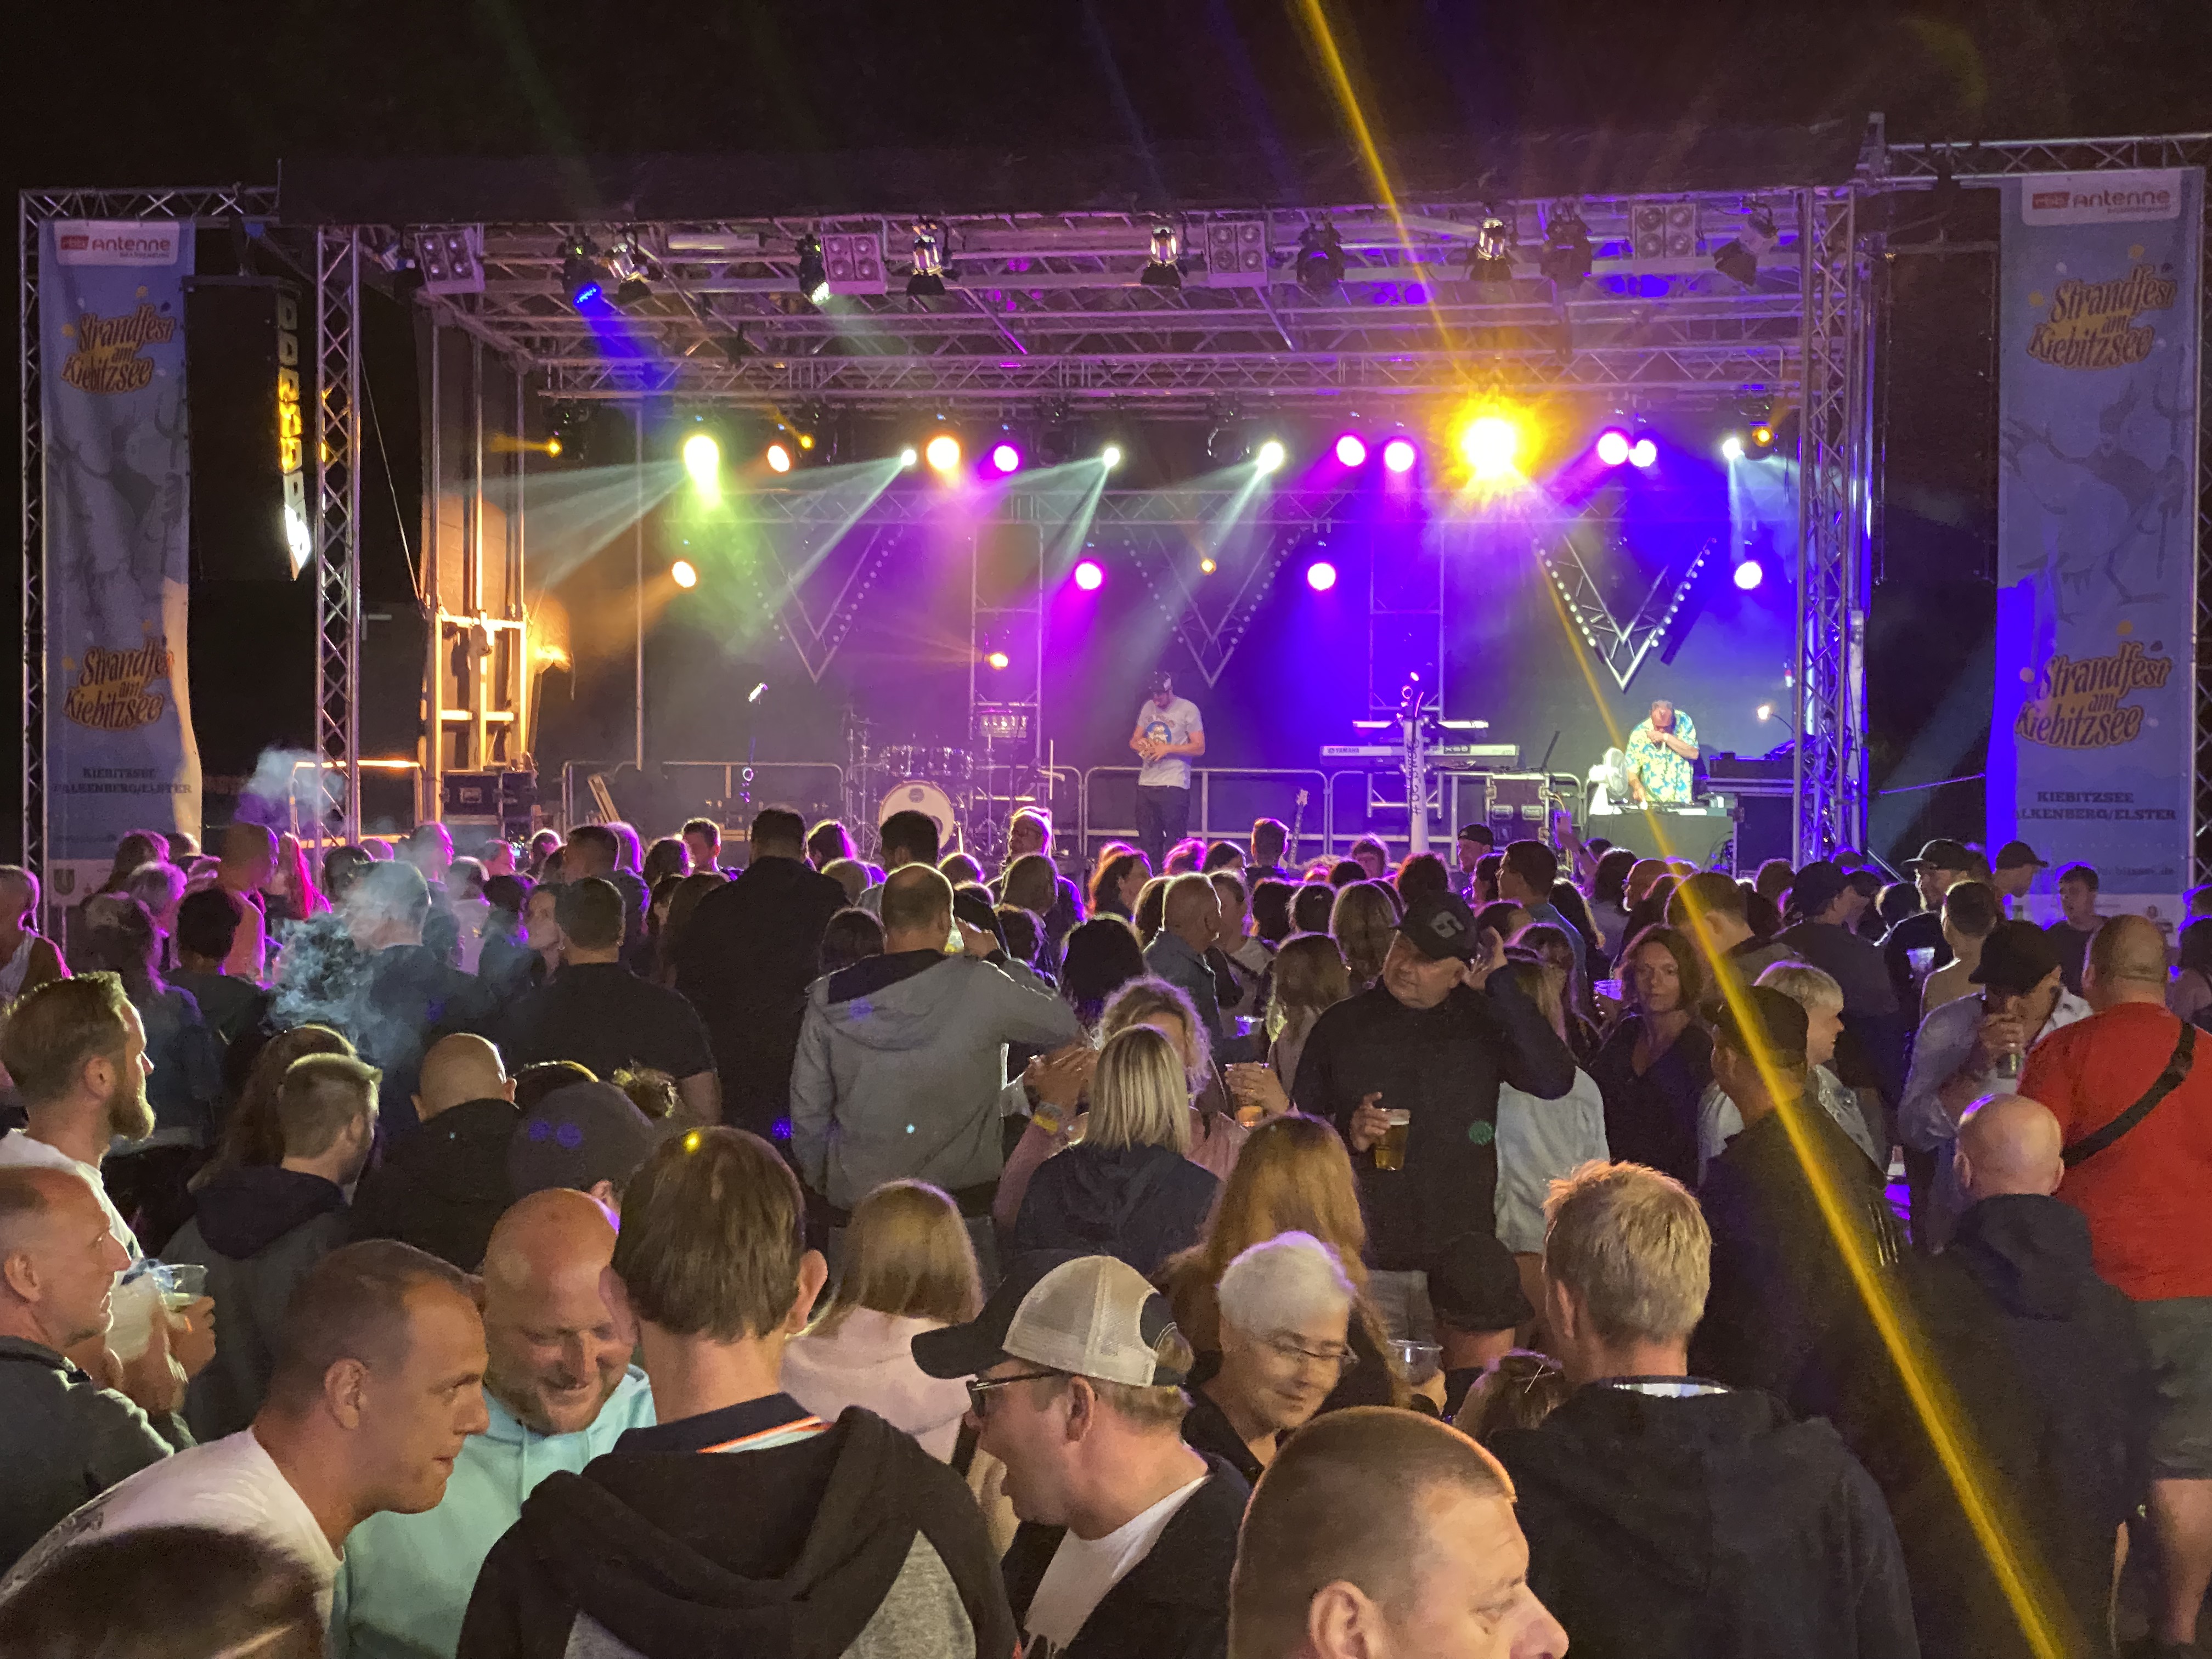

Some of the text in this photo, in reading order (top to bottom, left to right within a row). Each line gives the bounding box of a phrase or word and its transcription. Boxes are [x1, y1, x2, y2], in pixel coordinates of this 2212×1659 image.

[2073, 189, 2170, 208] Antenne
[92, 236, 170, 251] Antenne
[2051, 265, 2176, 323] Strandfest
[80, 637, 174, 686] Strandfe
[2036, 642, 2171, 700] Strandfest
[64, 688, 163, 728] Kiebitzsee
[2088, 693, 2118, 713] am
[2016, 703, 2142, 748] Kiebitzsee
[2037, 791, 2134, 803] KIEBITZSEE
[2015, 808, 2176, 820] LKENBERG/ELSTER
